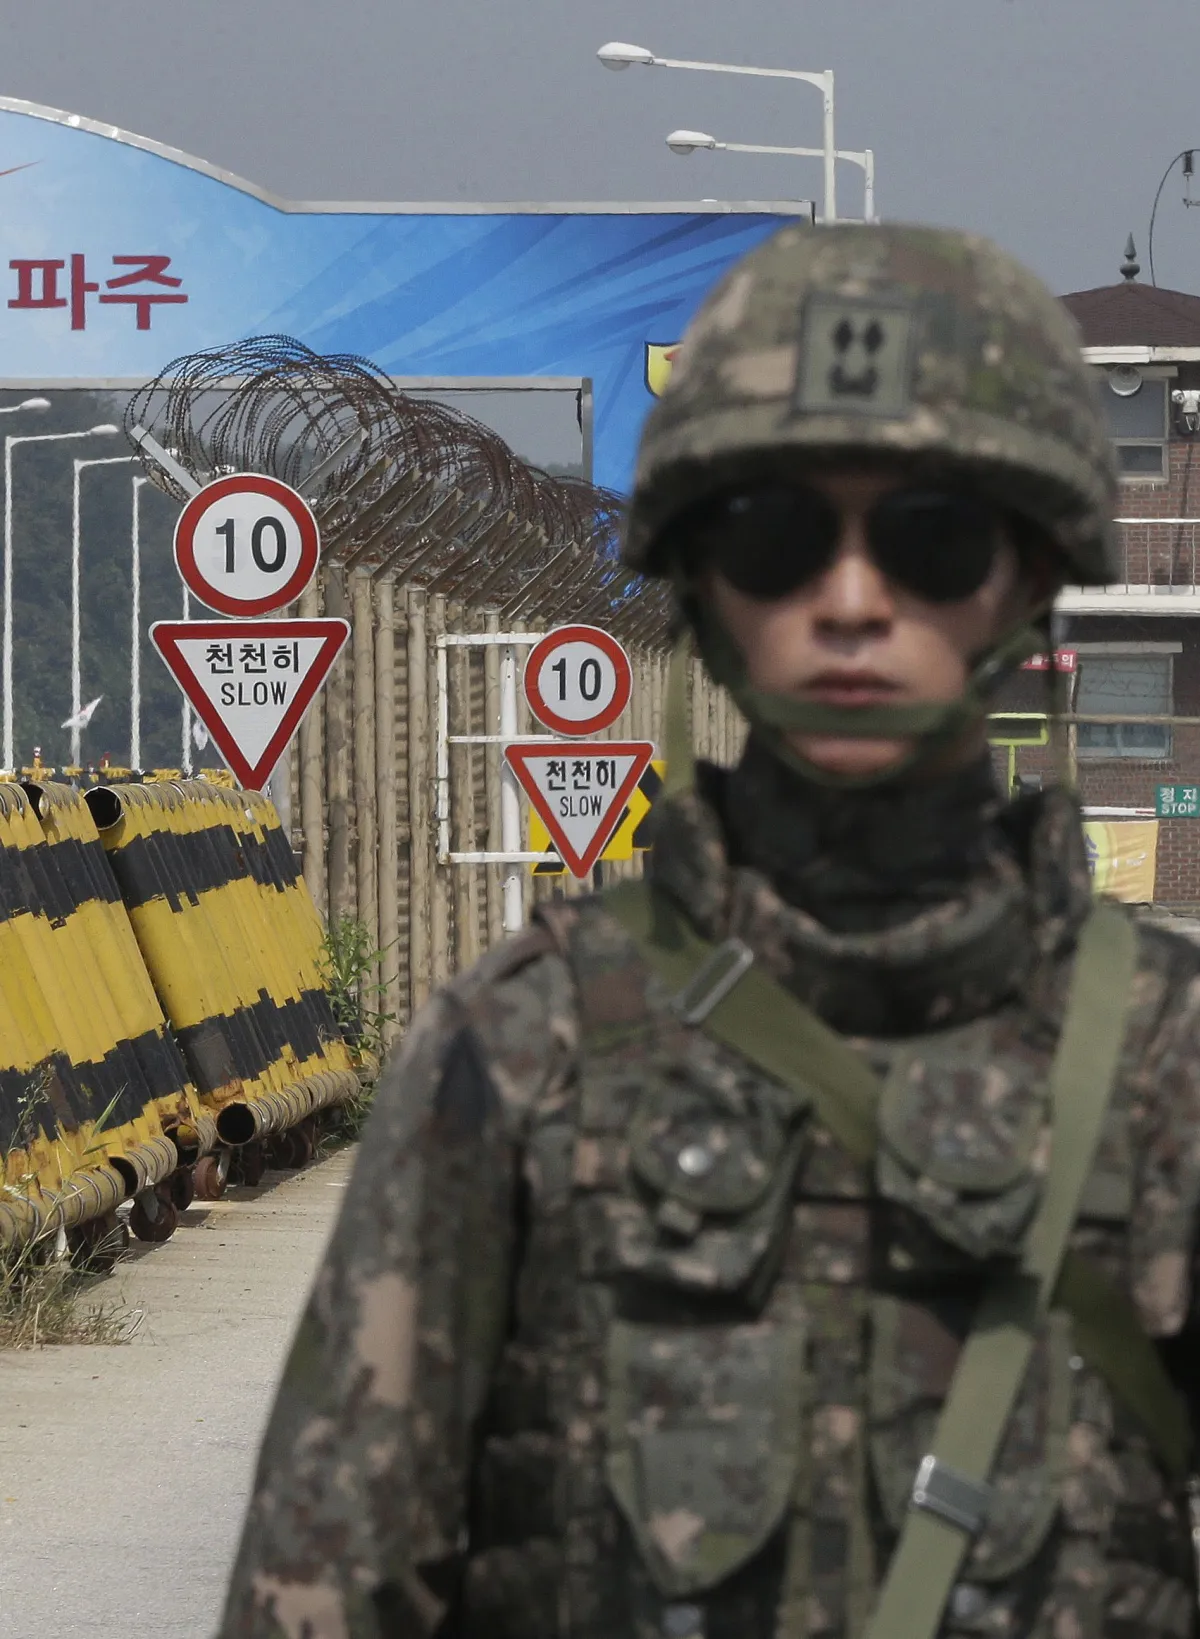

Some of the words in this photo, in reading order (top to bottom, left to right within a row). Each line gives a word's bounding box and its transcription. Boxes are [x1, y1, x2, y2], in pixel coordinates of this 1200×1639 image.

[8, 254, 189, 330] 파주
[215, 516, 287, 573] 10
[205, 641, 300, 674] 천천히
[221, 681, 287, 706] SLOW
[552, 658, 602, 701] 10
[546, 760, 616, 791] 천천히
[560, 796, 603, 817] SLOW
[1161, 803, 1197, 814] STOP
